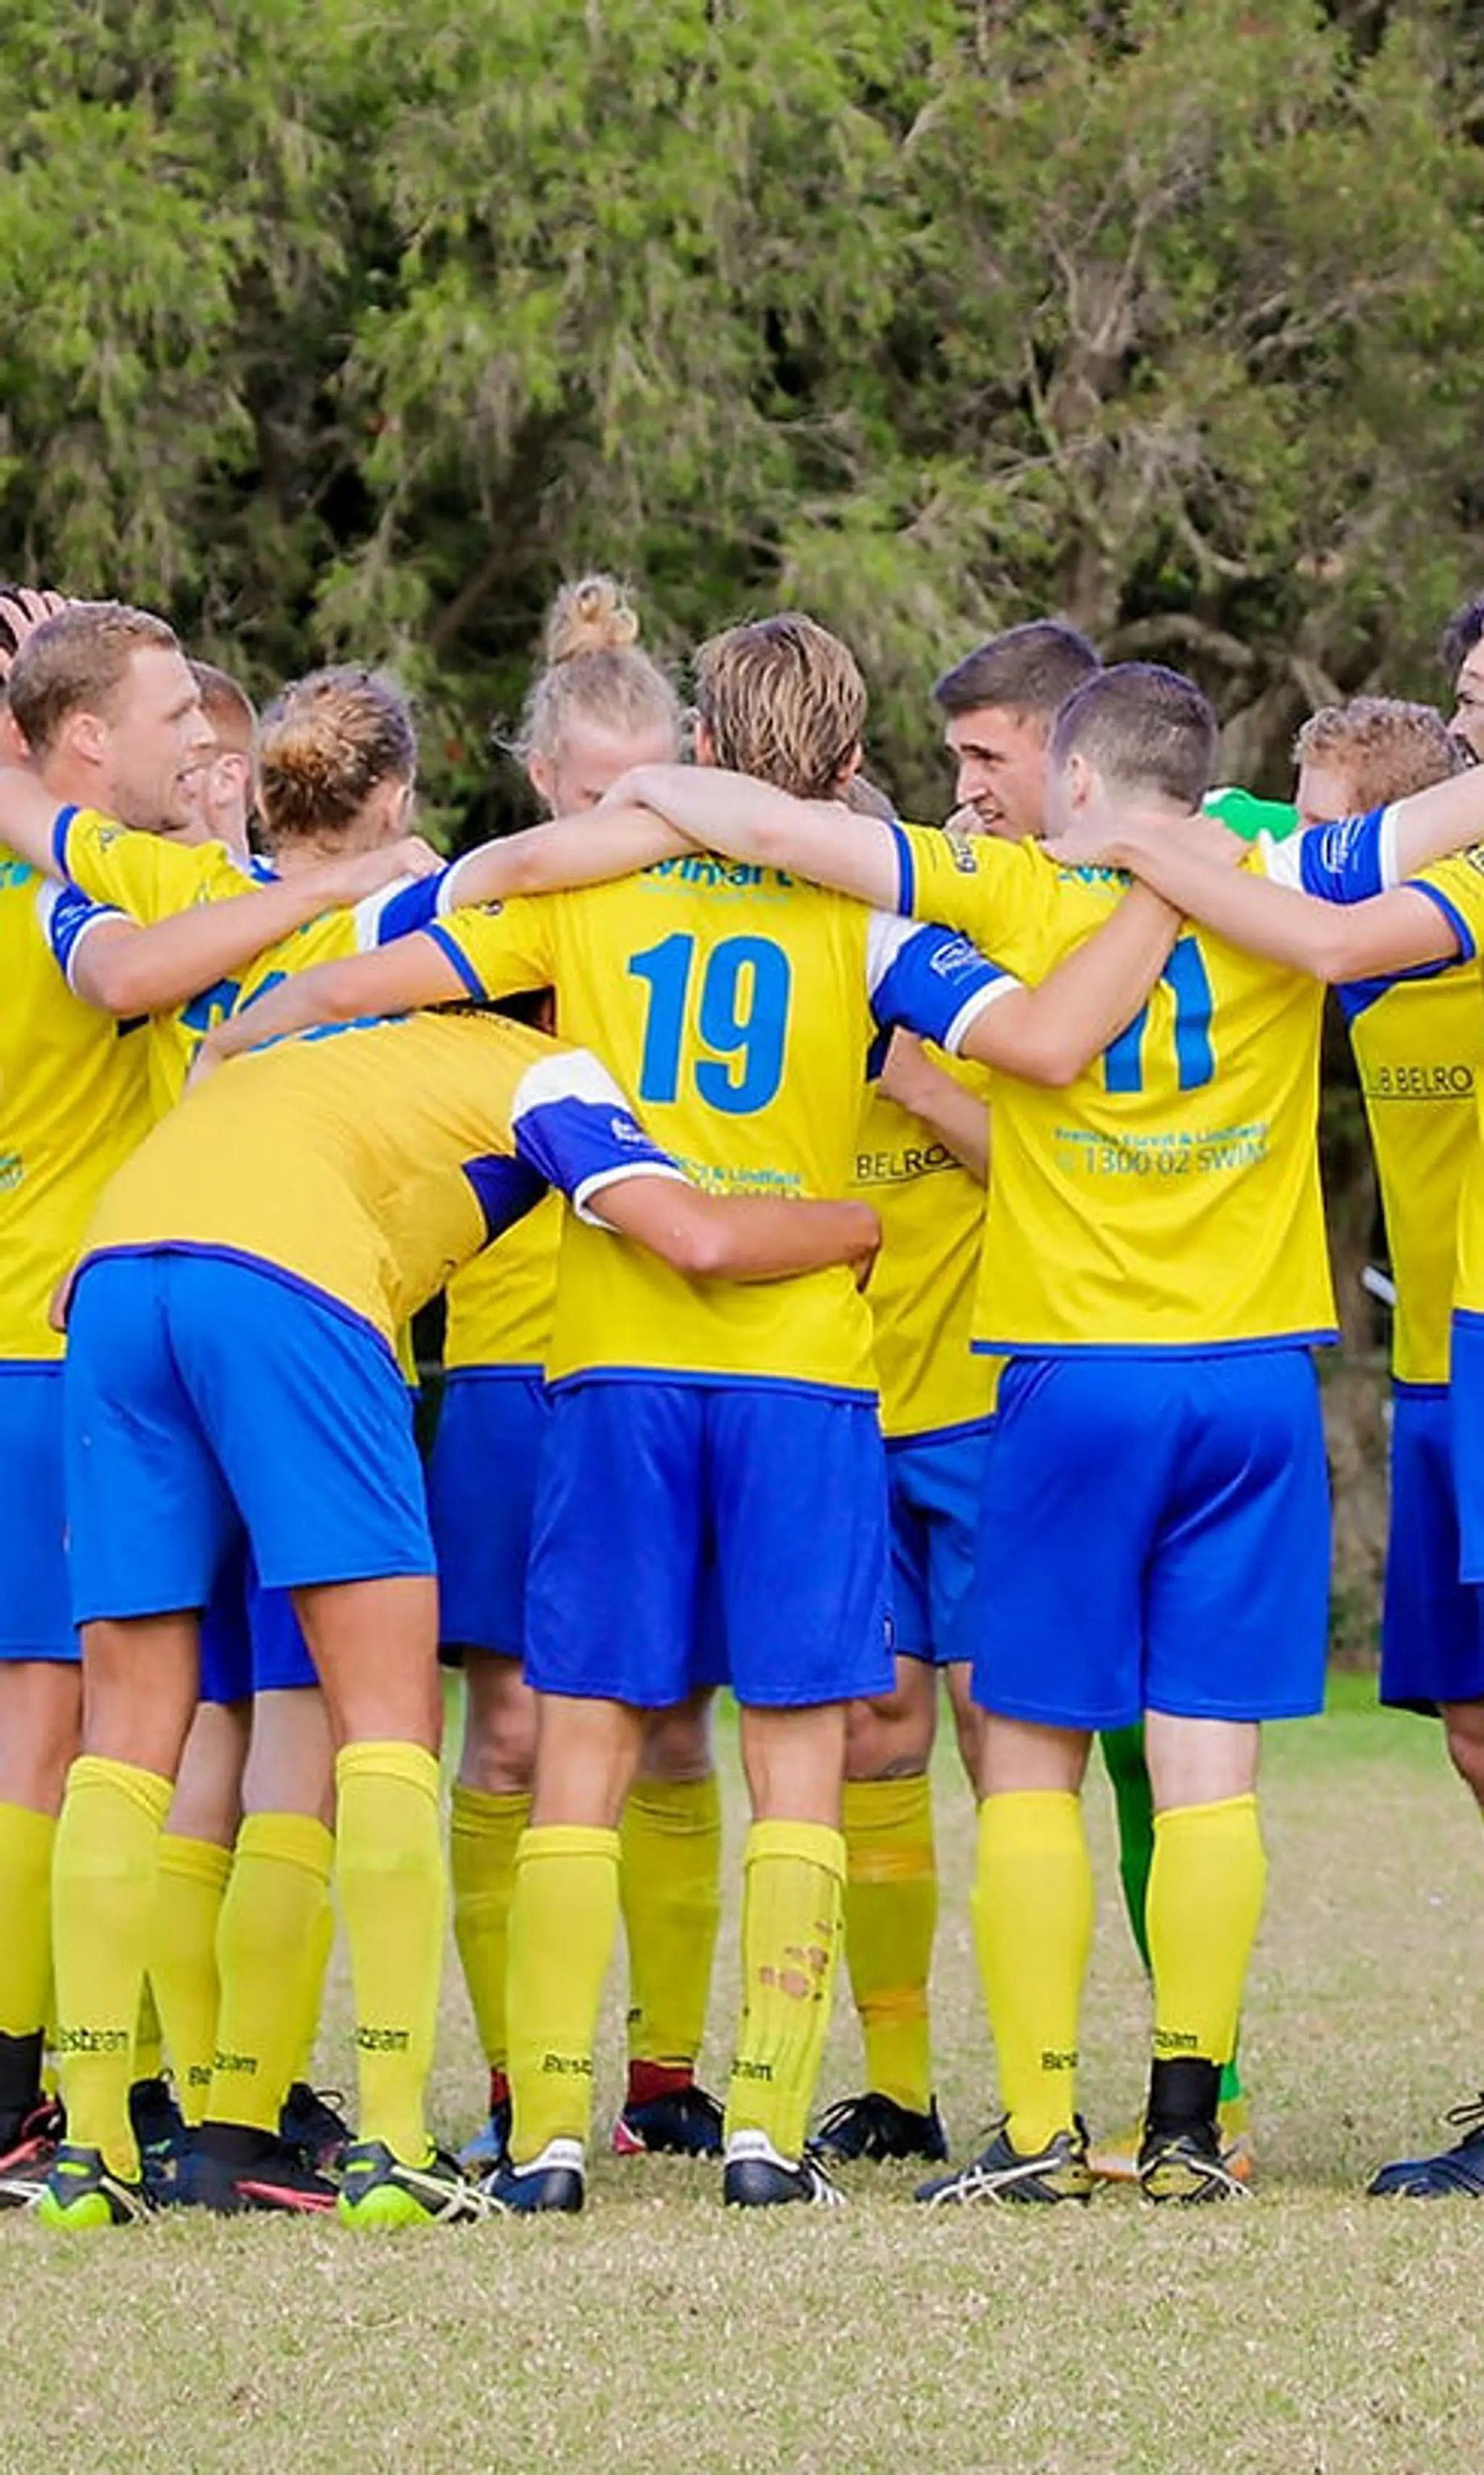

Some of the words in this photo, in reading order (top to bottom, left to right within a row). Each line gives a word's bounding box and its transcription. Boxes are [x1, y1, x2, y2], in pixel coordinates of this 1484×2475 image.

[628, 932, 791, 1115] 19
[1086, 1147, 1150, 1176] 1300
[1158, 1147, 1190, 1175] 02
[1196, 1139, 1268, 1170] SWIM
